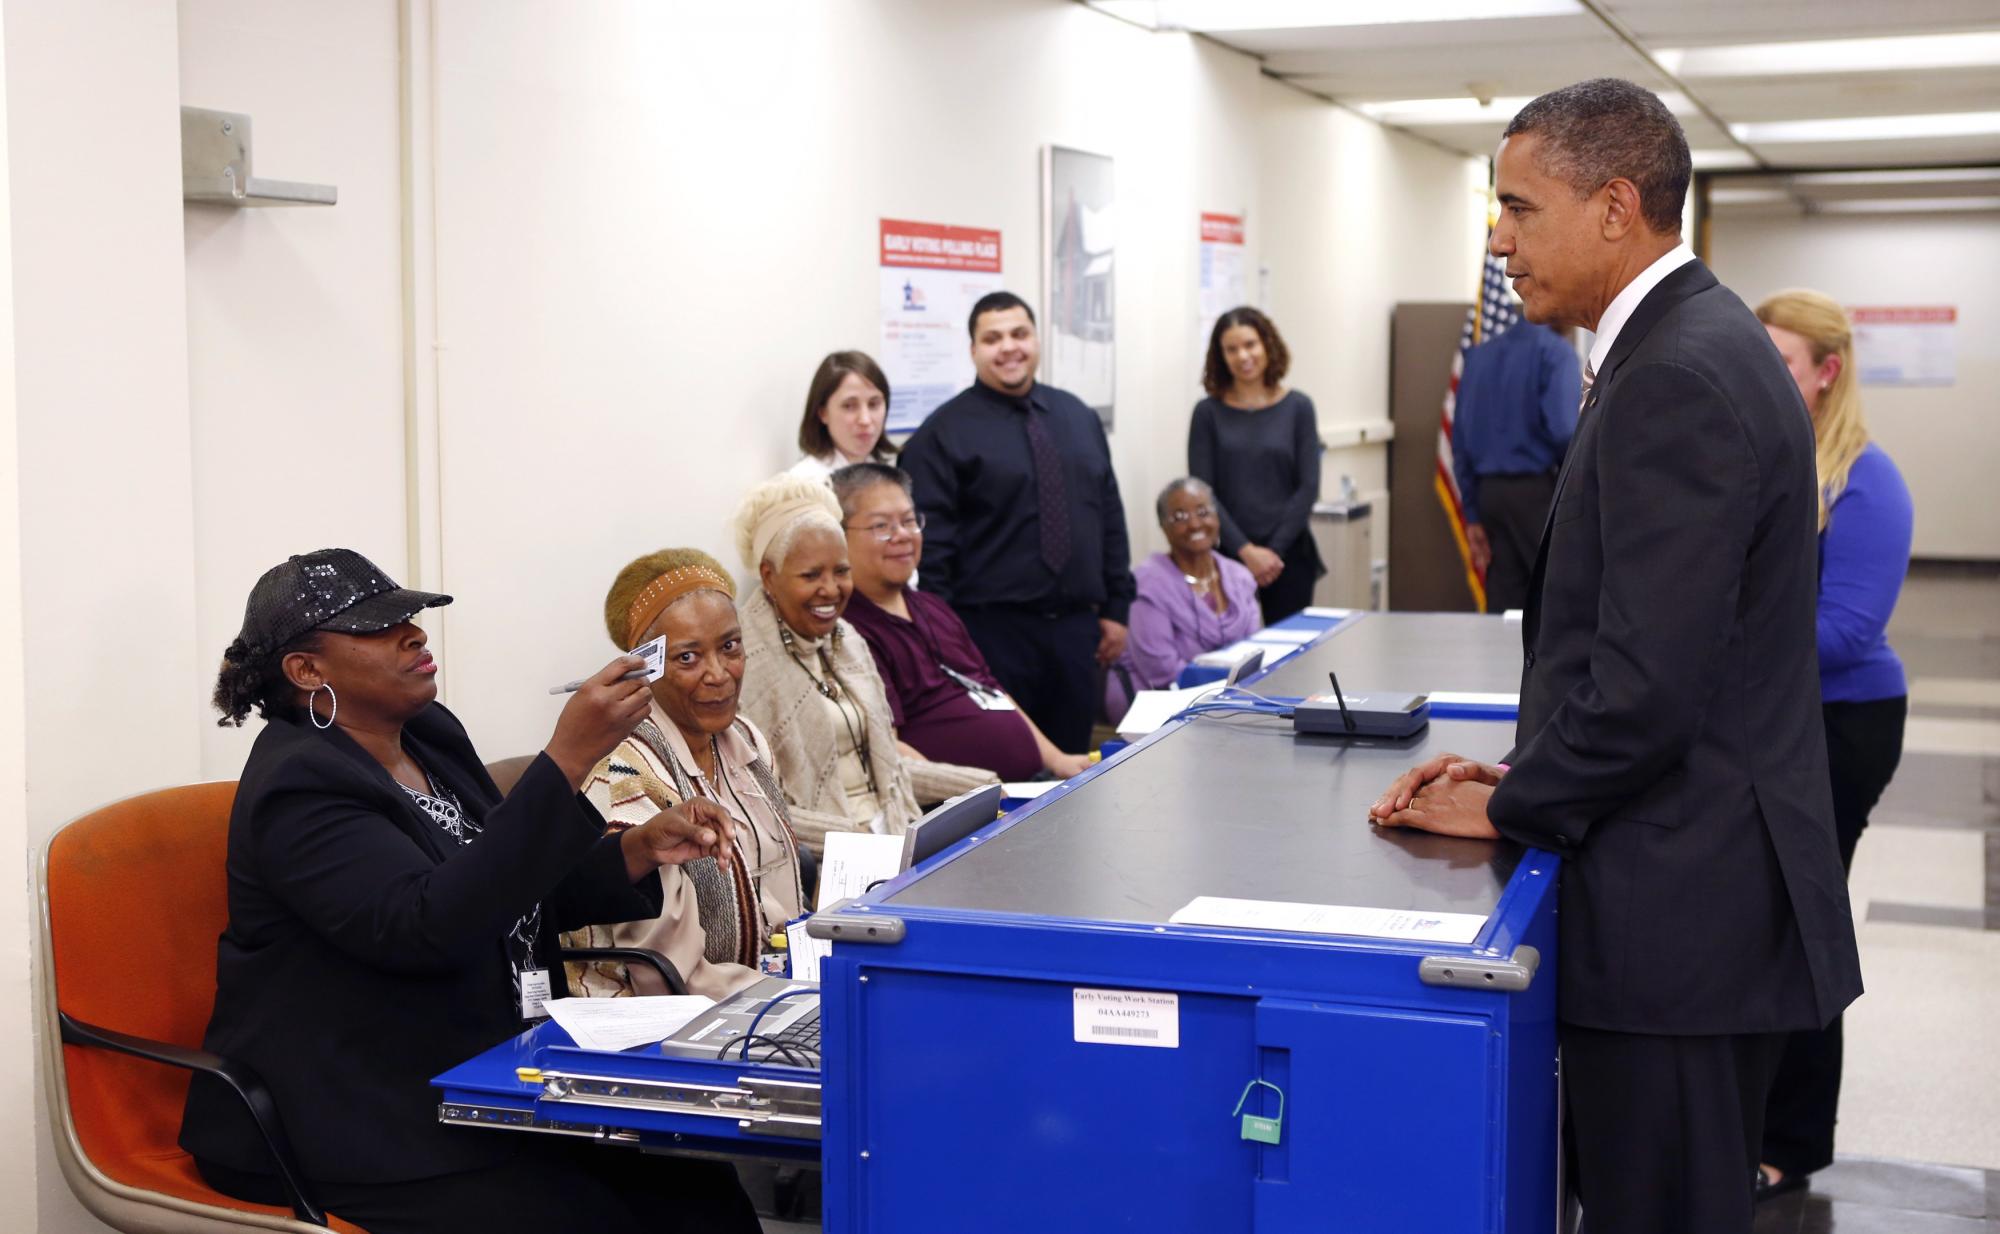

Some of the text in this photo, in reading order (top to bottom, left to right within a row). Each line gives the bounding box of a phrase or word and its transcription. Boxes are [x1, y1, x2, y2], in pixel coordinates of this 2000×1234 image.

[1075, 992, 1175, 1005] Early Voting Work Station
